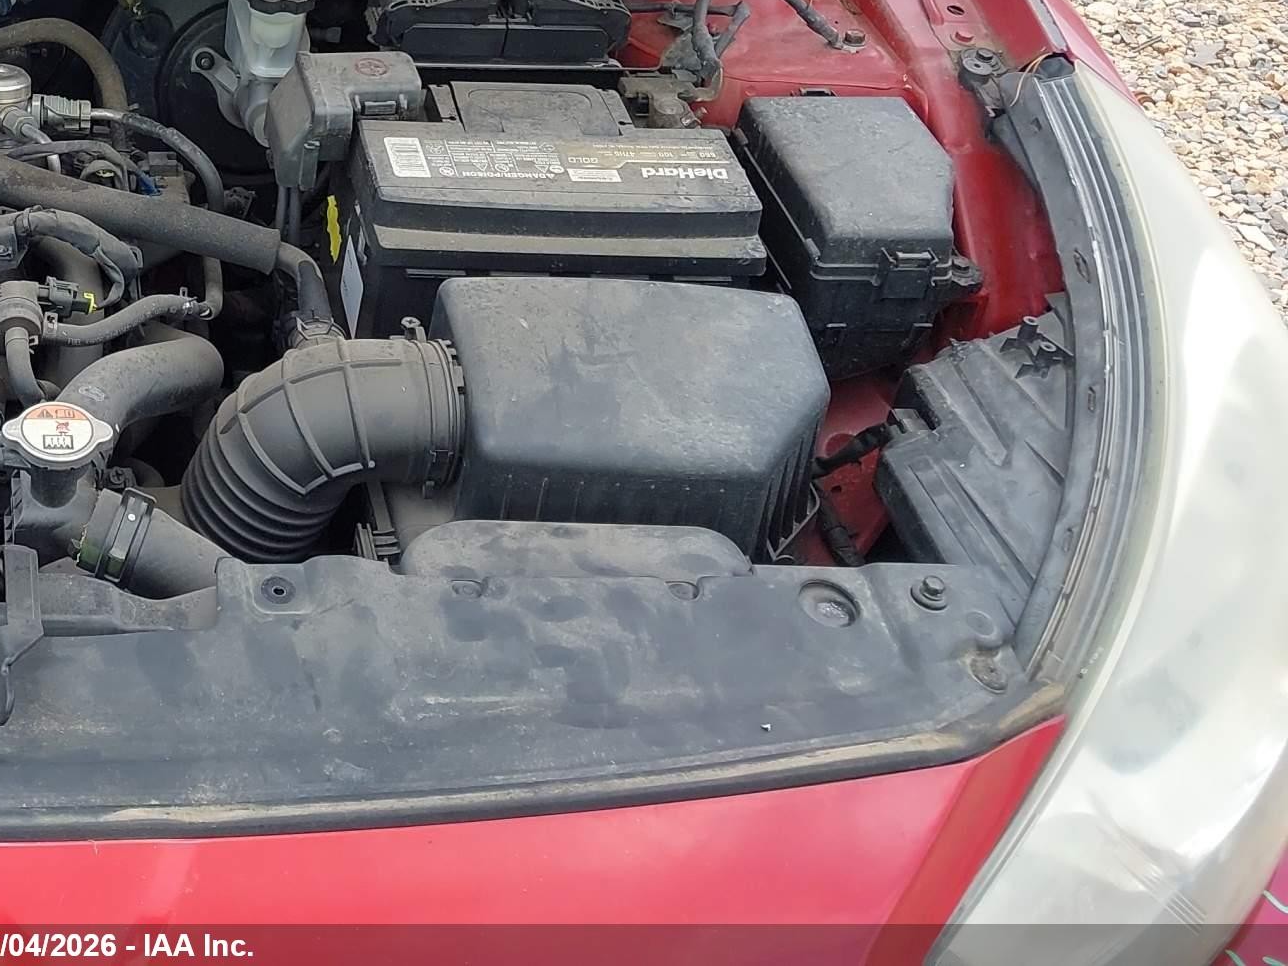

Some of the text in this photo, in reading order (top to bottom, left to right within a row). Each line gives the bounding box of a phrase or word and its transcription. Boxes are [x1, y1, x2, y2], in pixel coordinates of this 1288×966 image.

[568, 156, 599, 164] GOLD
[463, 170, 548, 180] DANGER/POISON
[640, 167, 729, 180] DieHard
